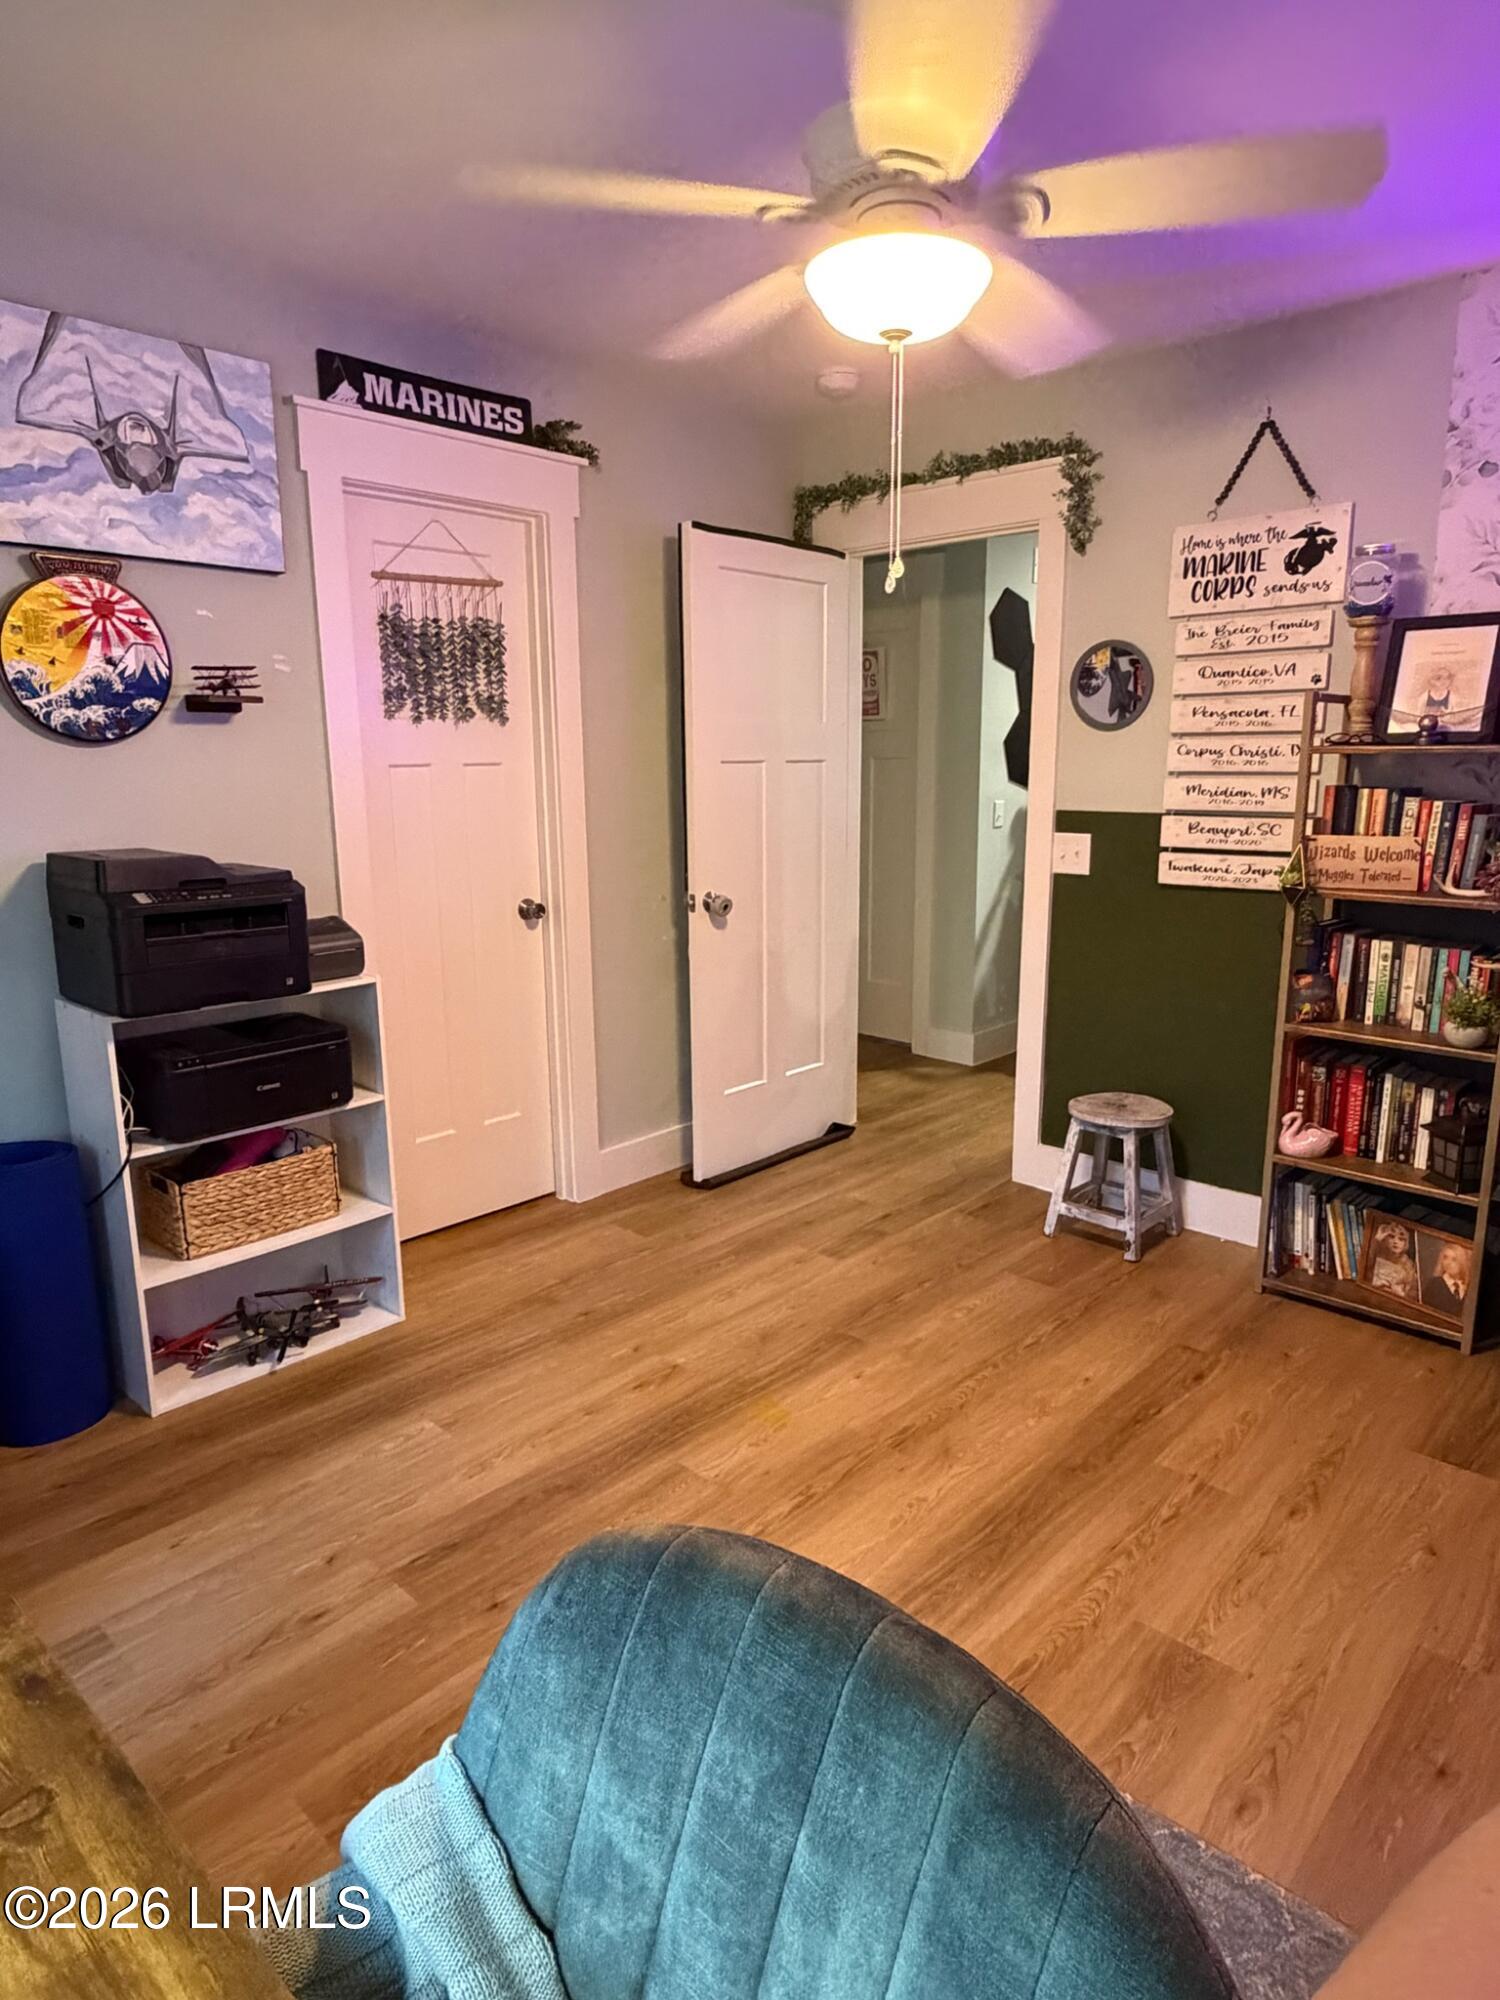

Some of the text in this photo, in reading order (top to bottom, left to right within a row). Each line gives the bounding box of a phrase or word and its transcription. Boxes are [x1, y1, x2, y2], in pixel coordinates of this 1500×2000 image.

[362, 371, 525, 436] MARINES
[1180, 526, 1288, 555] Home is where the
[1182, 547, 1270, 580] MARINE
[1191, 575, 1257, 603] CORPS
[1263, 579, 1310, 598] sends
[1311, 579, 1333, 592] us
[1269, 618, 1320, 632] Family
[1246, 632, 1289, 647] 2015
[1273, 662, 1297, 677] VA
[1280, 704, 1301, 718] FL
[1176, 743, 1225, 758] Corpus
[1261, 785, 1291, 800] MS
[1257, 822, 1282, 837] SC
[1364, 845, 1421, 863] Welcome
[1239, 862, 1283, 878] Japa
[1318, 868, 1402, 884] Muggles Tolerated
